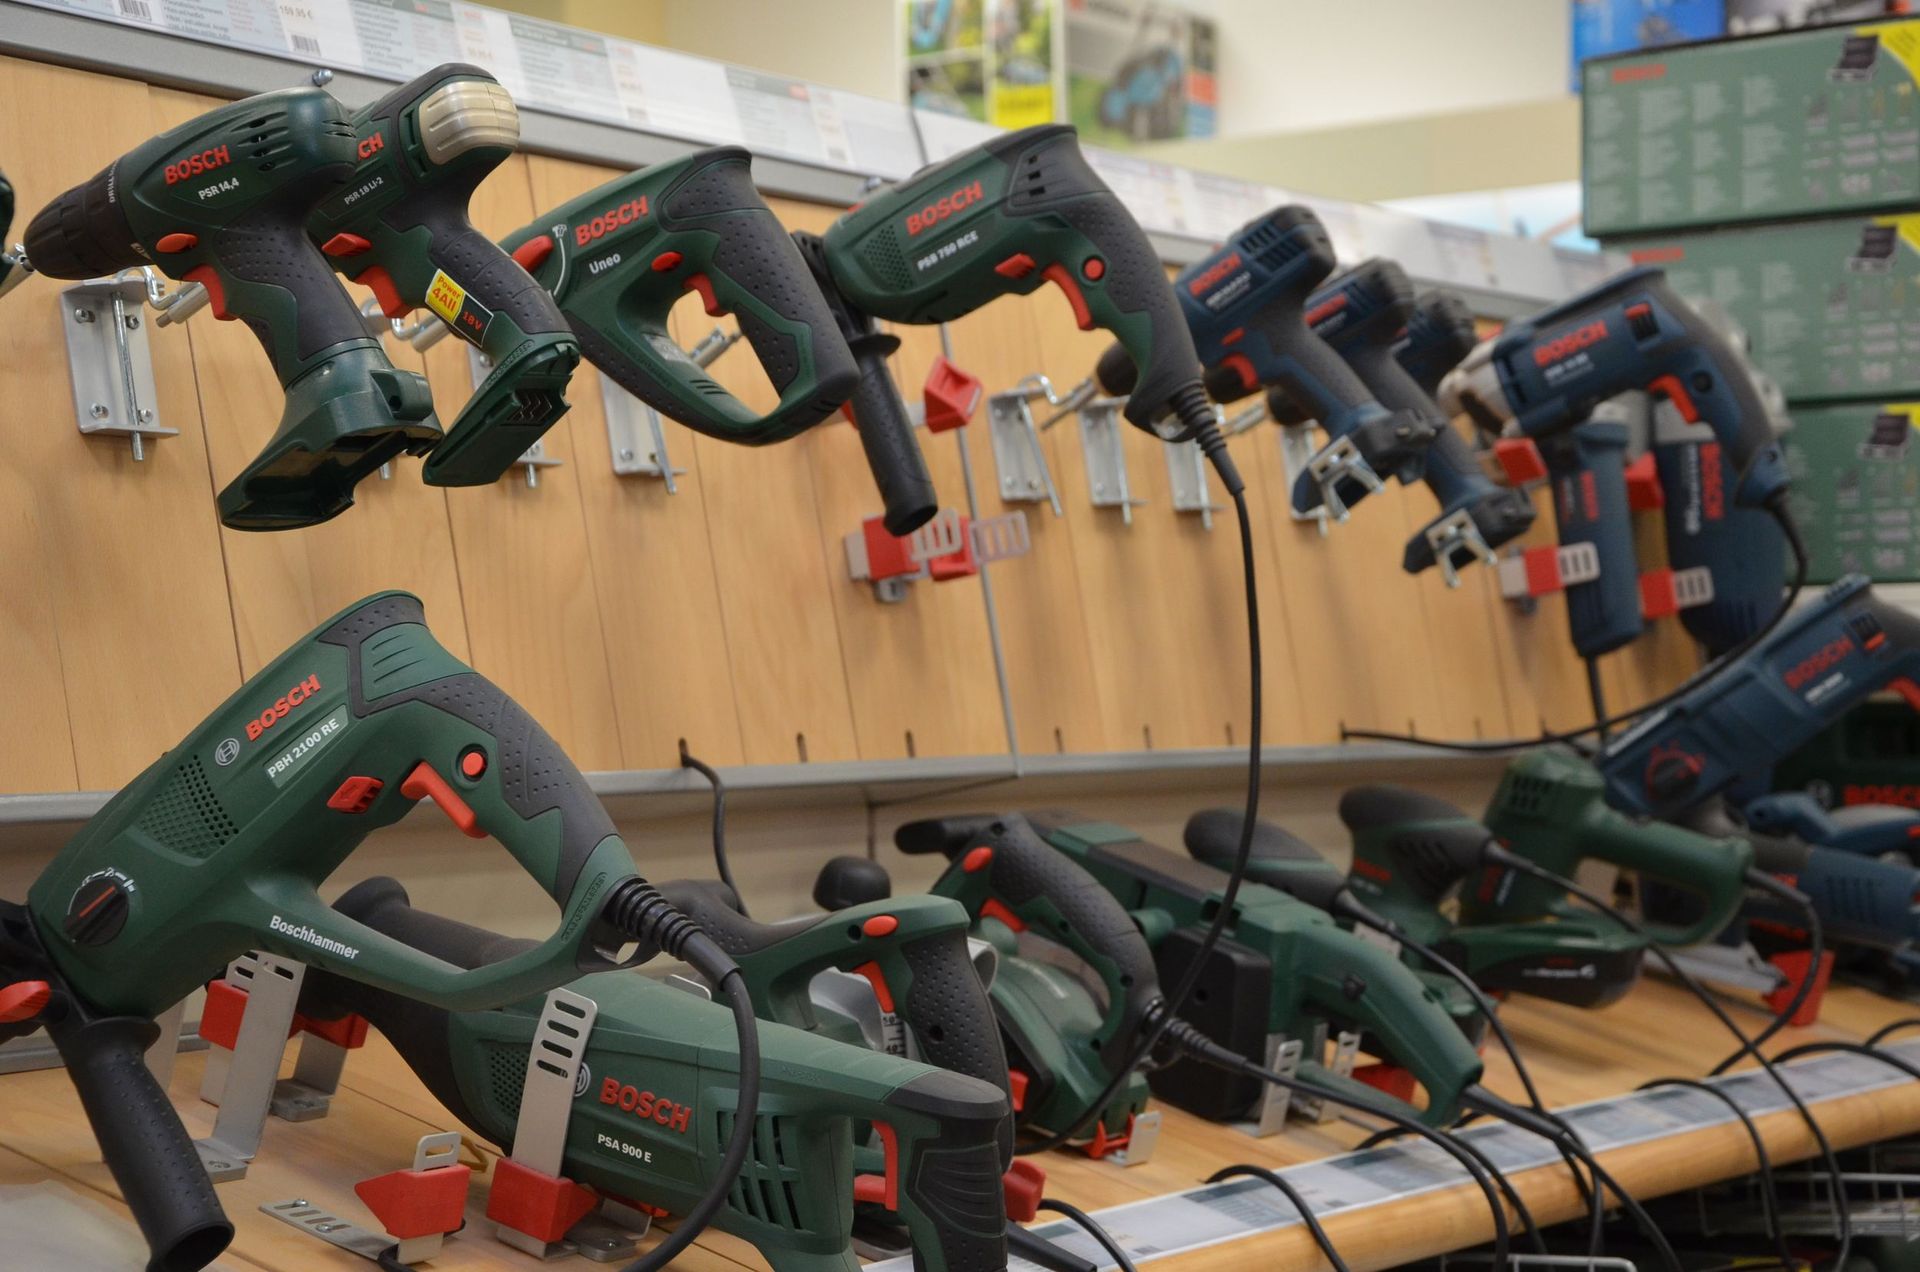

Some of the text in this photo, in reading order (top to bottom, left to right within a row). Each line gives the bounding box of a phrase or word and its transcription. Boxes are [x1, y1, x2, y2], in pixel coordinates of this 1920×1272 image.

[357, 131, 384, 160] CH
[164, 144, 231, 185] BOSCH
[198, 177, 239, 200] PSR 14,4
[344, 191, 360, 205] PSR
[359, 185, 370, 196] 18
[575, 194, 649, 247] BOSCH
[906, 181, 983, 235] BOSCH
[589, 253, 621, 274] Uneo
[917, 253, 938, 271] PSB
[432, 287, 457, 312] 4All
[437, 275, 461, 299] Power
[245, 673, 321, 742] BOSCH
[267, 718, 340, 778] PBH 2100 RE
[270, 914, 359, 959] Boschhammer
[599, 1077, 692, 1133] BOSCH
[597, 1133, 652, 1163] PSA 900 E
